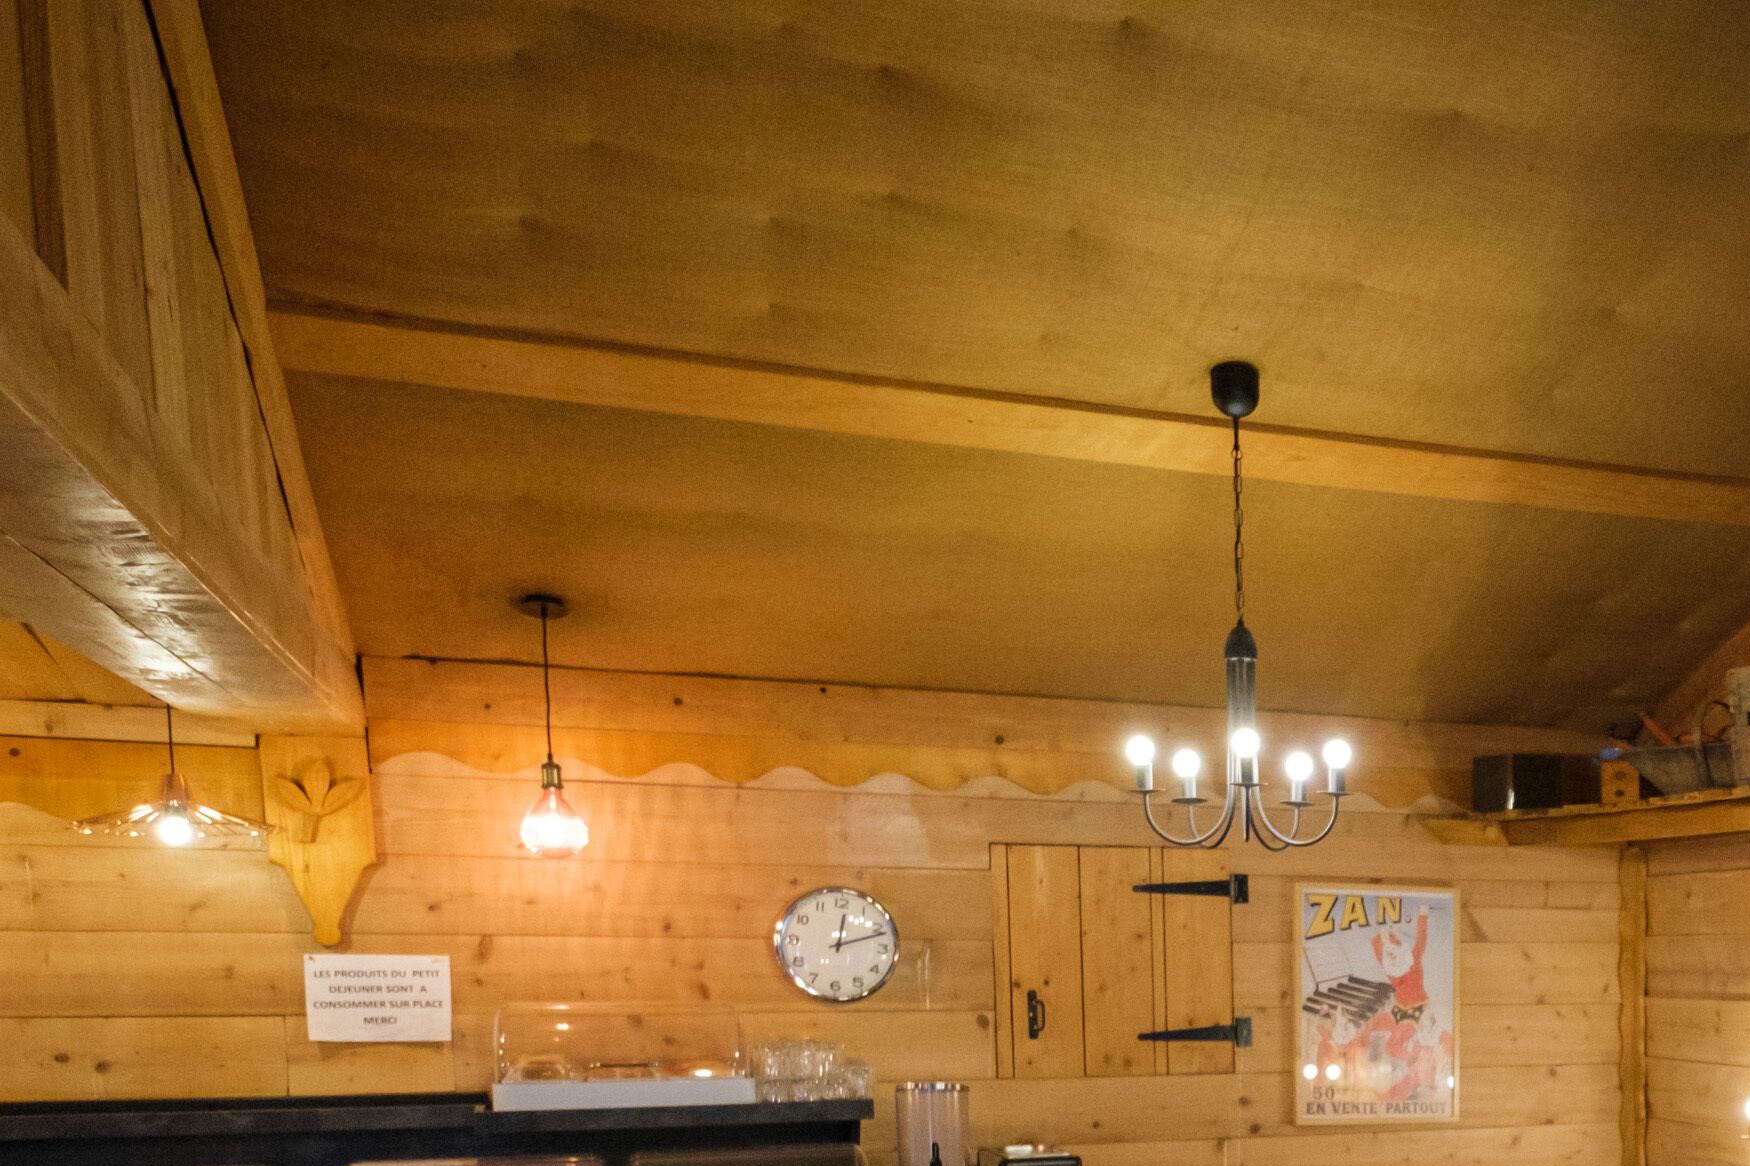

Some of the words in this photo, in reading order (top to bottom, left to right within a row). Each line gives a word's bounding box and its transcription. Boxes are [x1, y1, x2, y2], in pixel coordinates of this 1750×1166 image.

[816, 901, 825, 912] 11
[834, 898, 849, 910] 12
[797, 914, 809, 926] 10
[788, 934, 799, 946] 9
[876, 943, 888, 955] 3
[792, 956, 804, 968] 8
[313, 969, 331, 978] LES
[334, 969, 388, 978] PRODUITS
[391, 969, 407, 978] DU
[412, 969, 440, 978] PETIT
[869, 964, 879, 975] 4
[809, 972, 819, 984] 7
[853, 976, 864, 989] 5
[328, 985, 383, 994] DEJEUNER
[386, 985, 414, 994] SONT
[420, 985, 427, 993] A
[830, 980, 841, 992] 6
[313, 1000, 386, 1009] CONSOMMER
[389, 1000, 410, 1009] SUR
[413, 1000, 443, 1009] PLACE
[363, 1016, 398, 1025] MERCI
[1312, 1086, 1335, 1100] 50
[1306, 1102, 1326, 1115] EN
[1330, 1102, 1377, 1115] VENTE
[1385, 1102, 1447, 1115] PARTOUT
